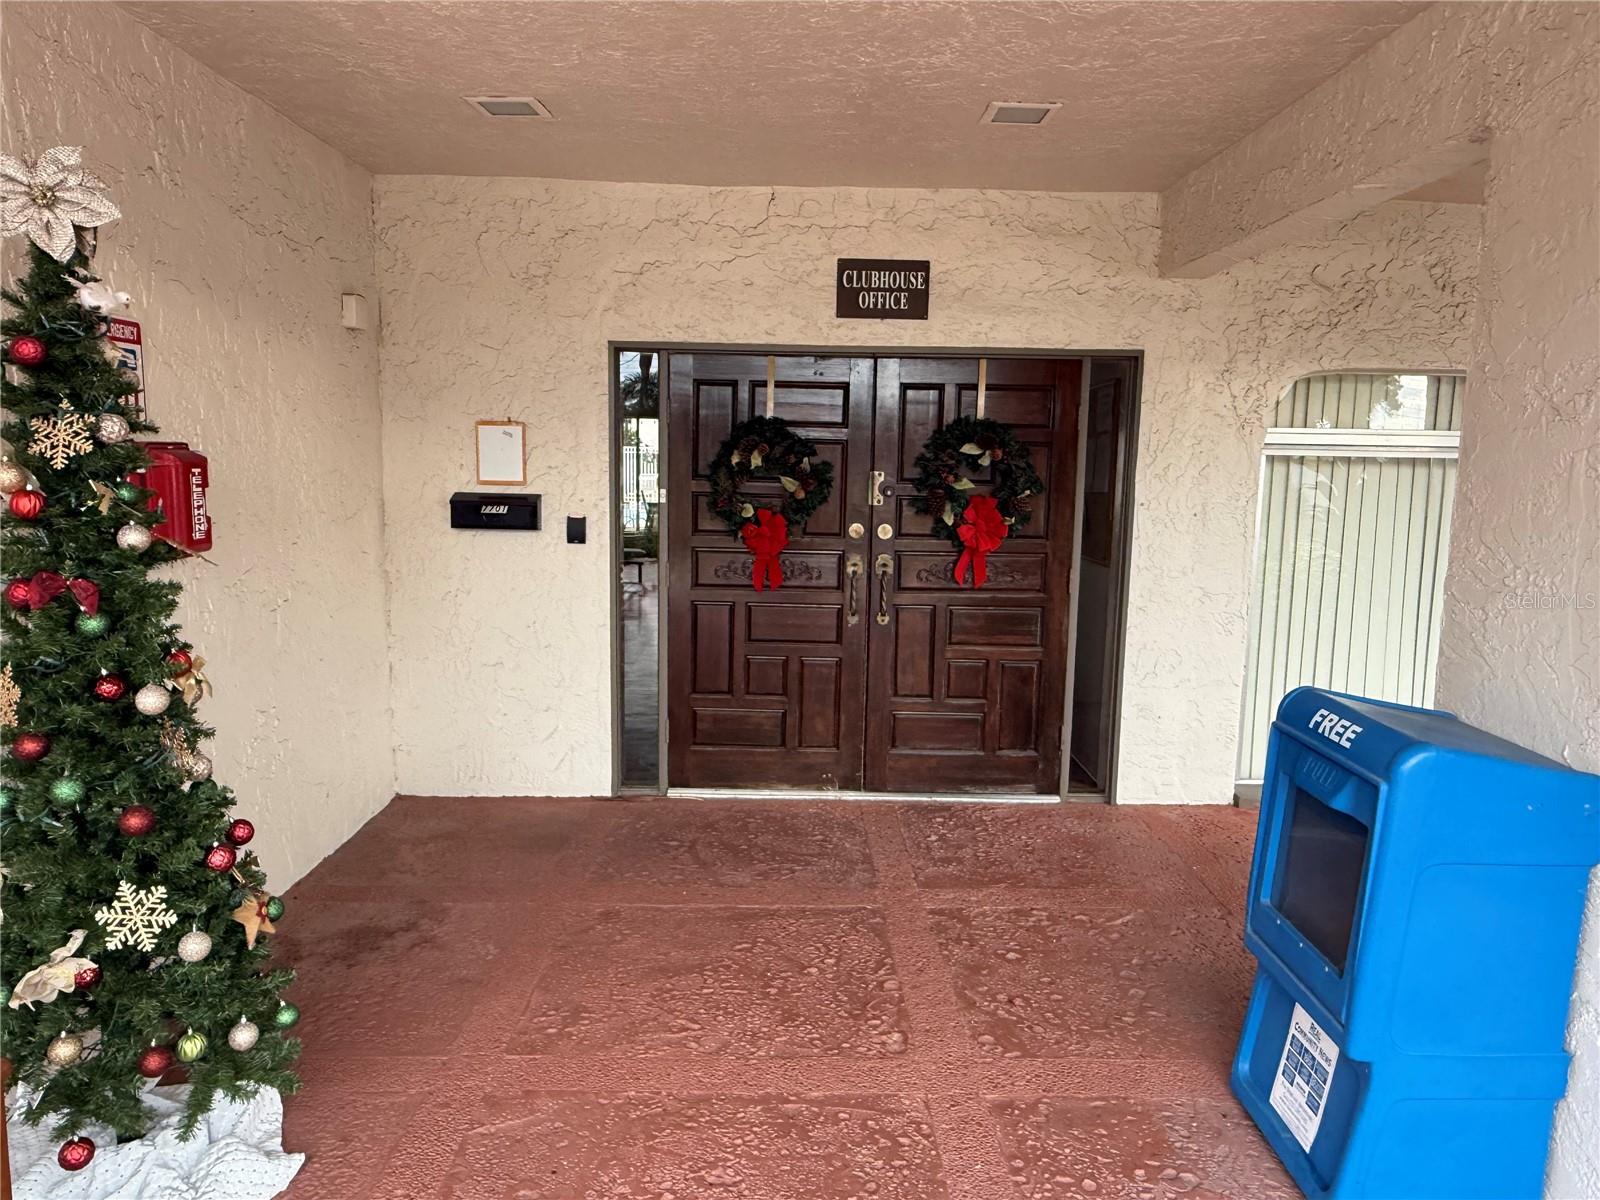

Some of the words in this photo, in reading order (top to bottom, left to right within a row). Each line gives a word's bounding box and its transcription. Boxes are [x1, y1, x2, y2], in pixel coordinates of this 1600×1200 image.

[843, 271, 926, 289] CLUBHOUSE
[858, 291, 909, 309] OFFICE
[107, 322, 137, 341] RGENCY
[191, 468, 206, 539] TELEPHONE
[1308, 708, 1363, 749] FREE
